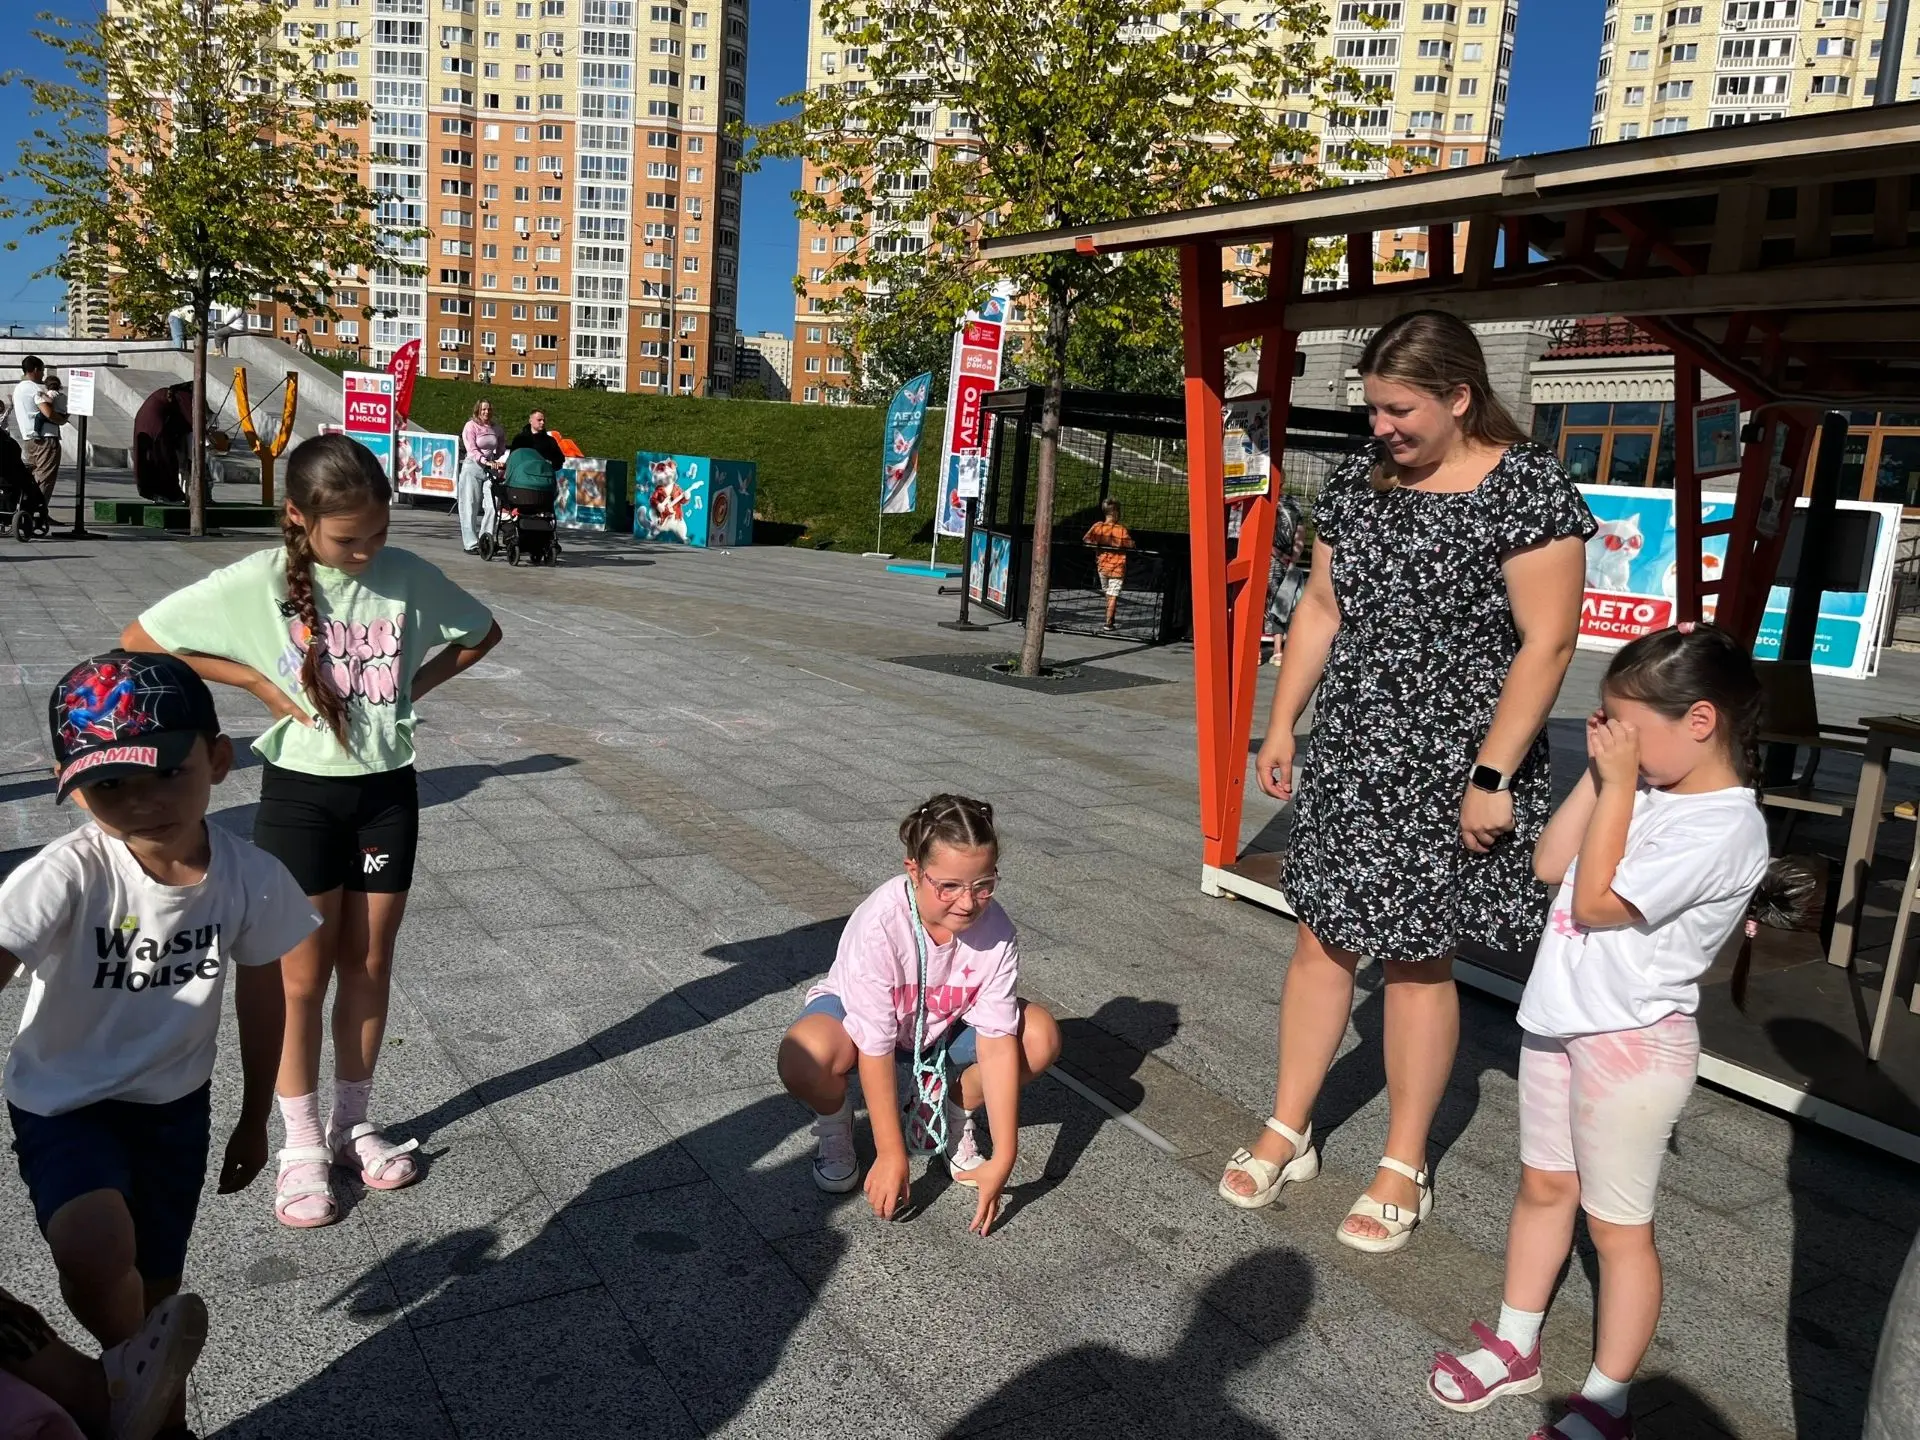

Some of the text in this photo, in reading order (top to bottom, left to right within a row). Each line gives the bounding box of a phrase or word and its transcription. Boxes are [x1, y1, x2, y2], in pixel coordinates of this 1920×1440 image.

[349, 401, 388, 416] ЛЕТО
[356, 415, 387, 424] МОСКВЕ
[960, 386, 978, 445] ЛЕТО
[1581, 597, 1655, 623] ЛЕТО
[103, 746, 158, 768] MAN
[92, 960, 220, 992] House
